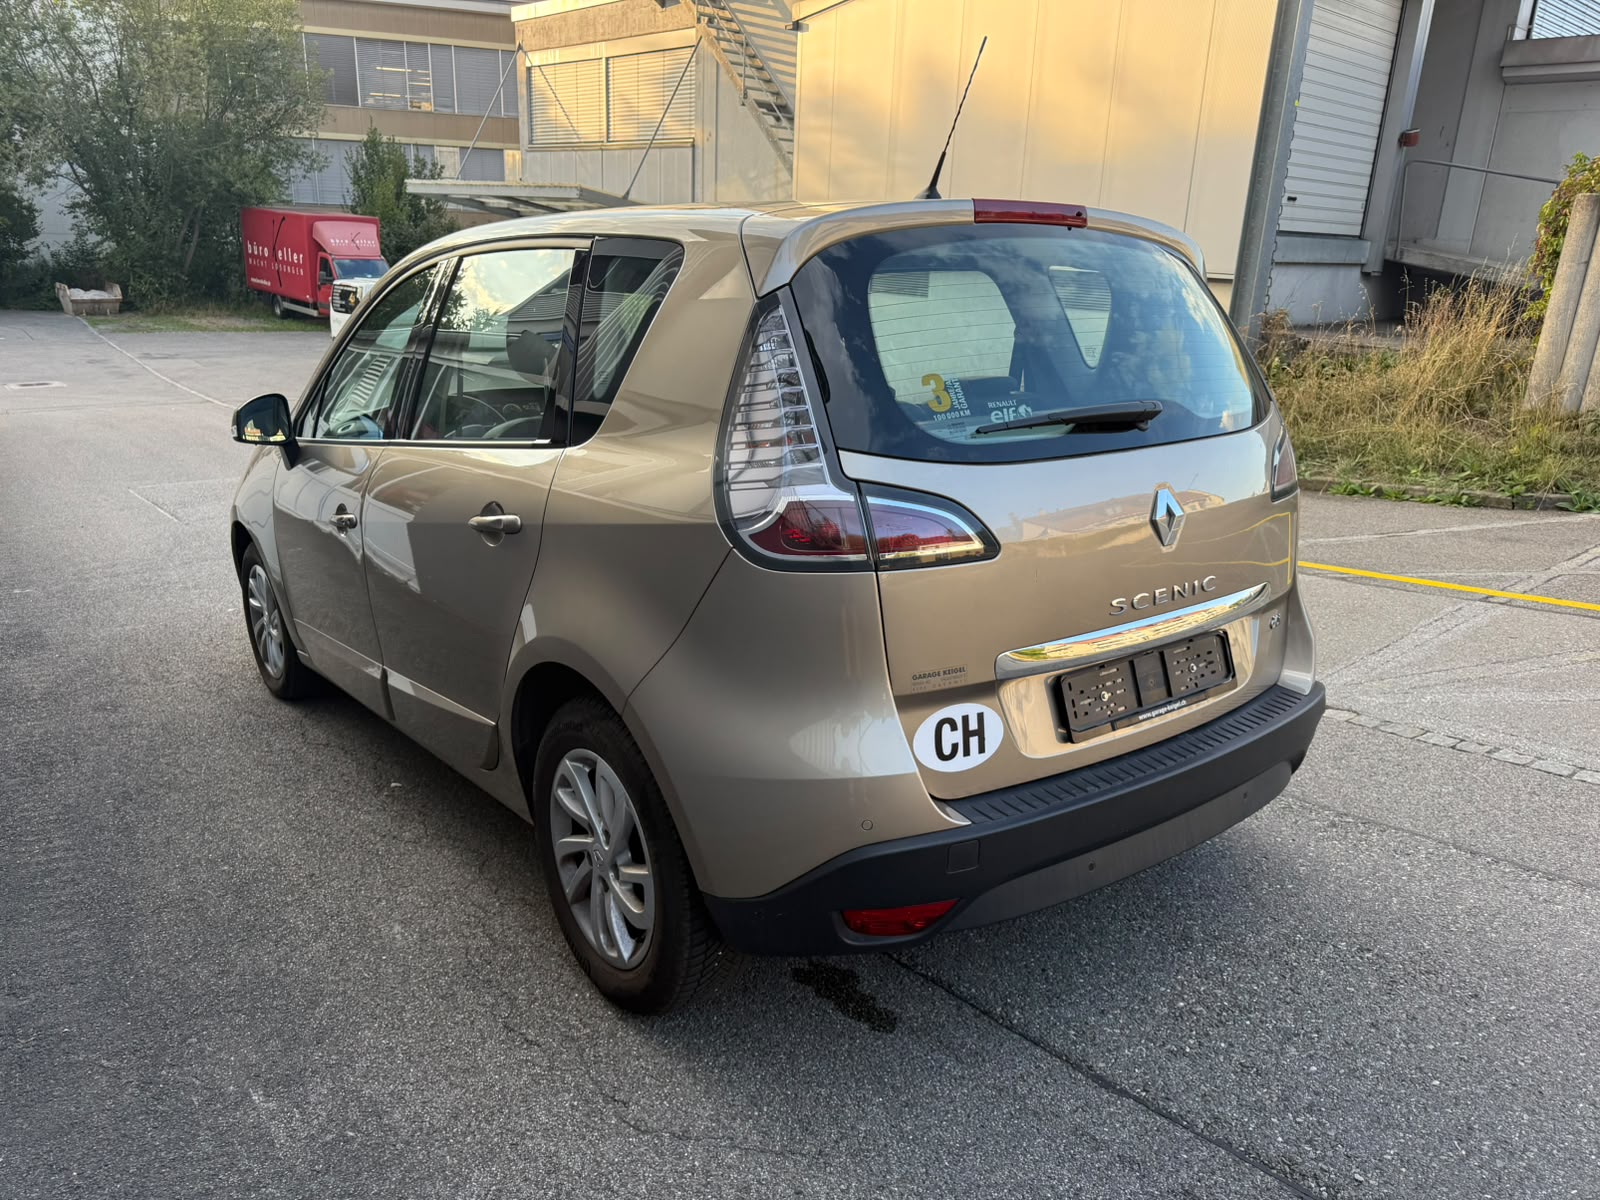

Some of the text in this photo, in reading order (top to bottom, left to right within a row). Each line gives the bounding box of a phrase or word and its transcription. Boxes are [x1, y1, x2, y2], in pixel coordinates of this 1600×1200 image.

[247, 240, 269, 257] büro
[921, 373, 952, 413] 3
[987, 399, 1017, 409] RENAULT
[960, 409, 971, 417] KM
[990, 407, 1016, 424] elf
[1108, 575, 1217, 616] SCENIC
[911, 671, 942, 681] GARAGE
[934, 711, 986, 762] CH
